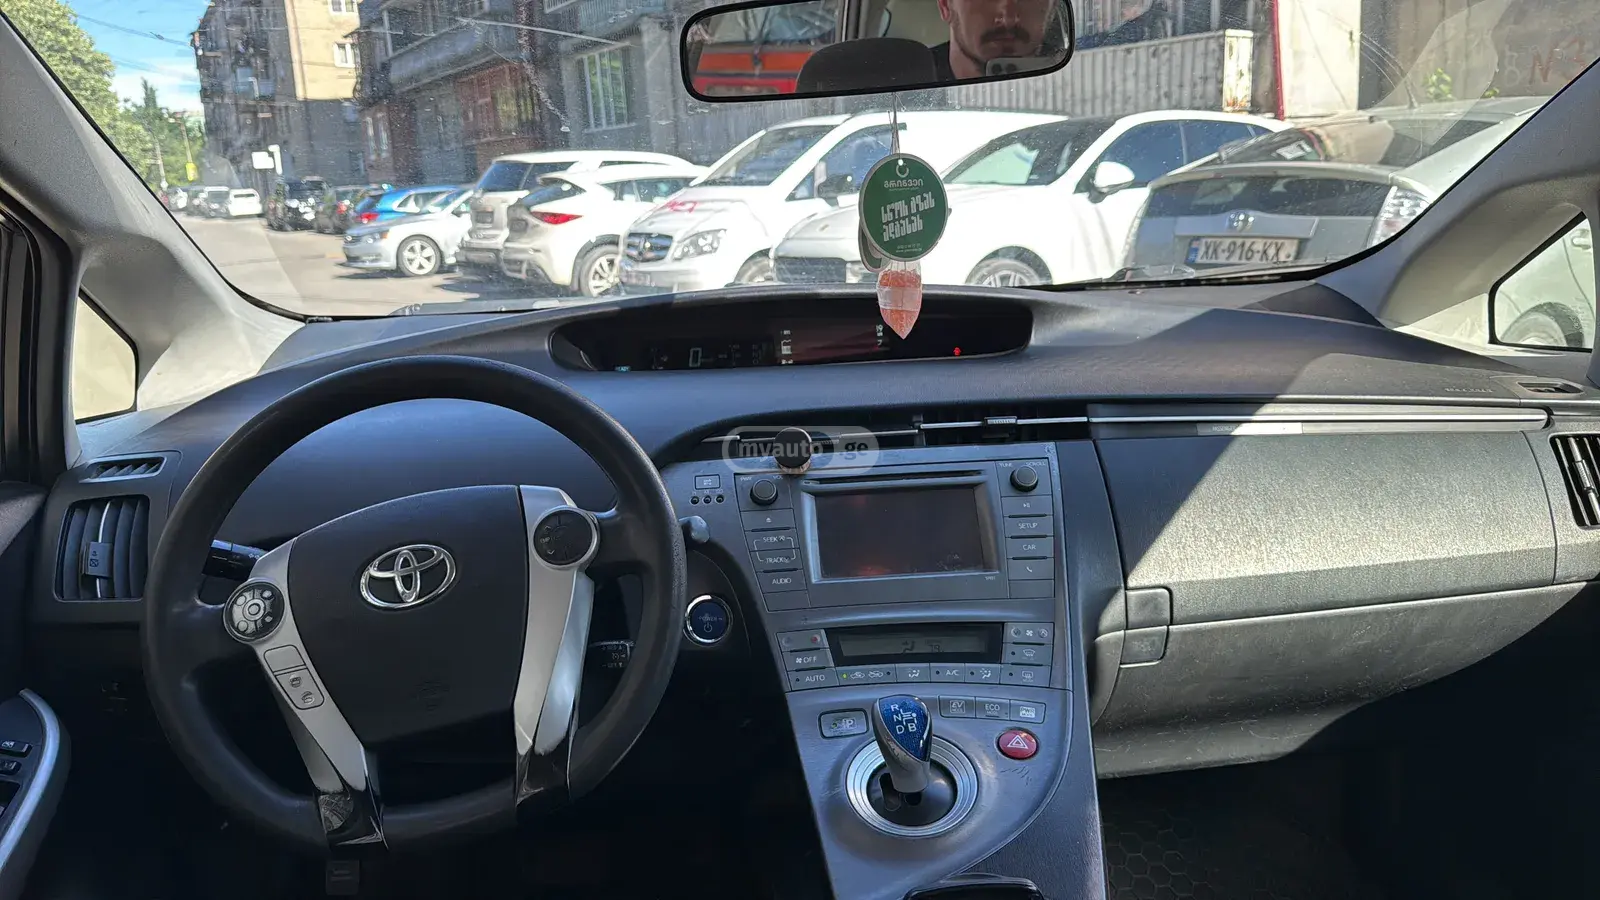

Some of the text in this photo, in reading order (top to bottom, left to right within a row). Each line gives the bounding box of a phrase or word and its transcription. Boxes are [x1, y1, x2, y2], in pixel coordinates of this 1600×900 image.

[1200, 240, 1286, 262] XK-916-KX
[771, 577, 792, 585] AUDIO
[805, 674, 826, 683] AUTO
[891, 704, 899, 712] R
[985, 703, 1000, 711] ECO
[896, 723, 917, 734] D B
